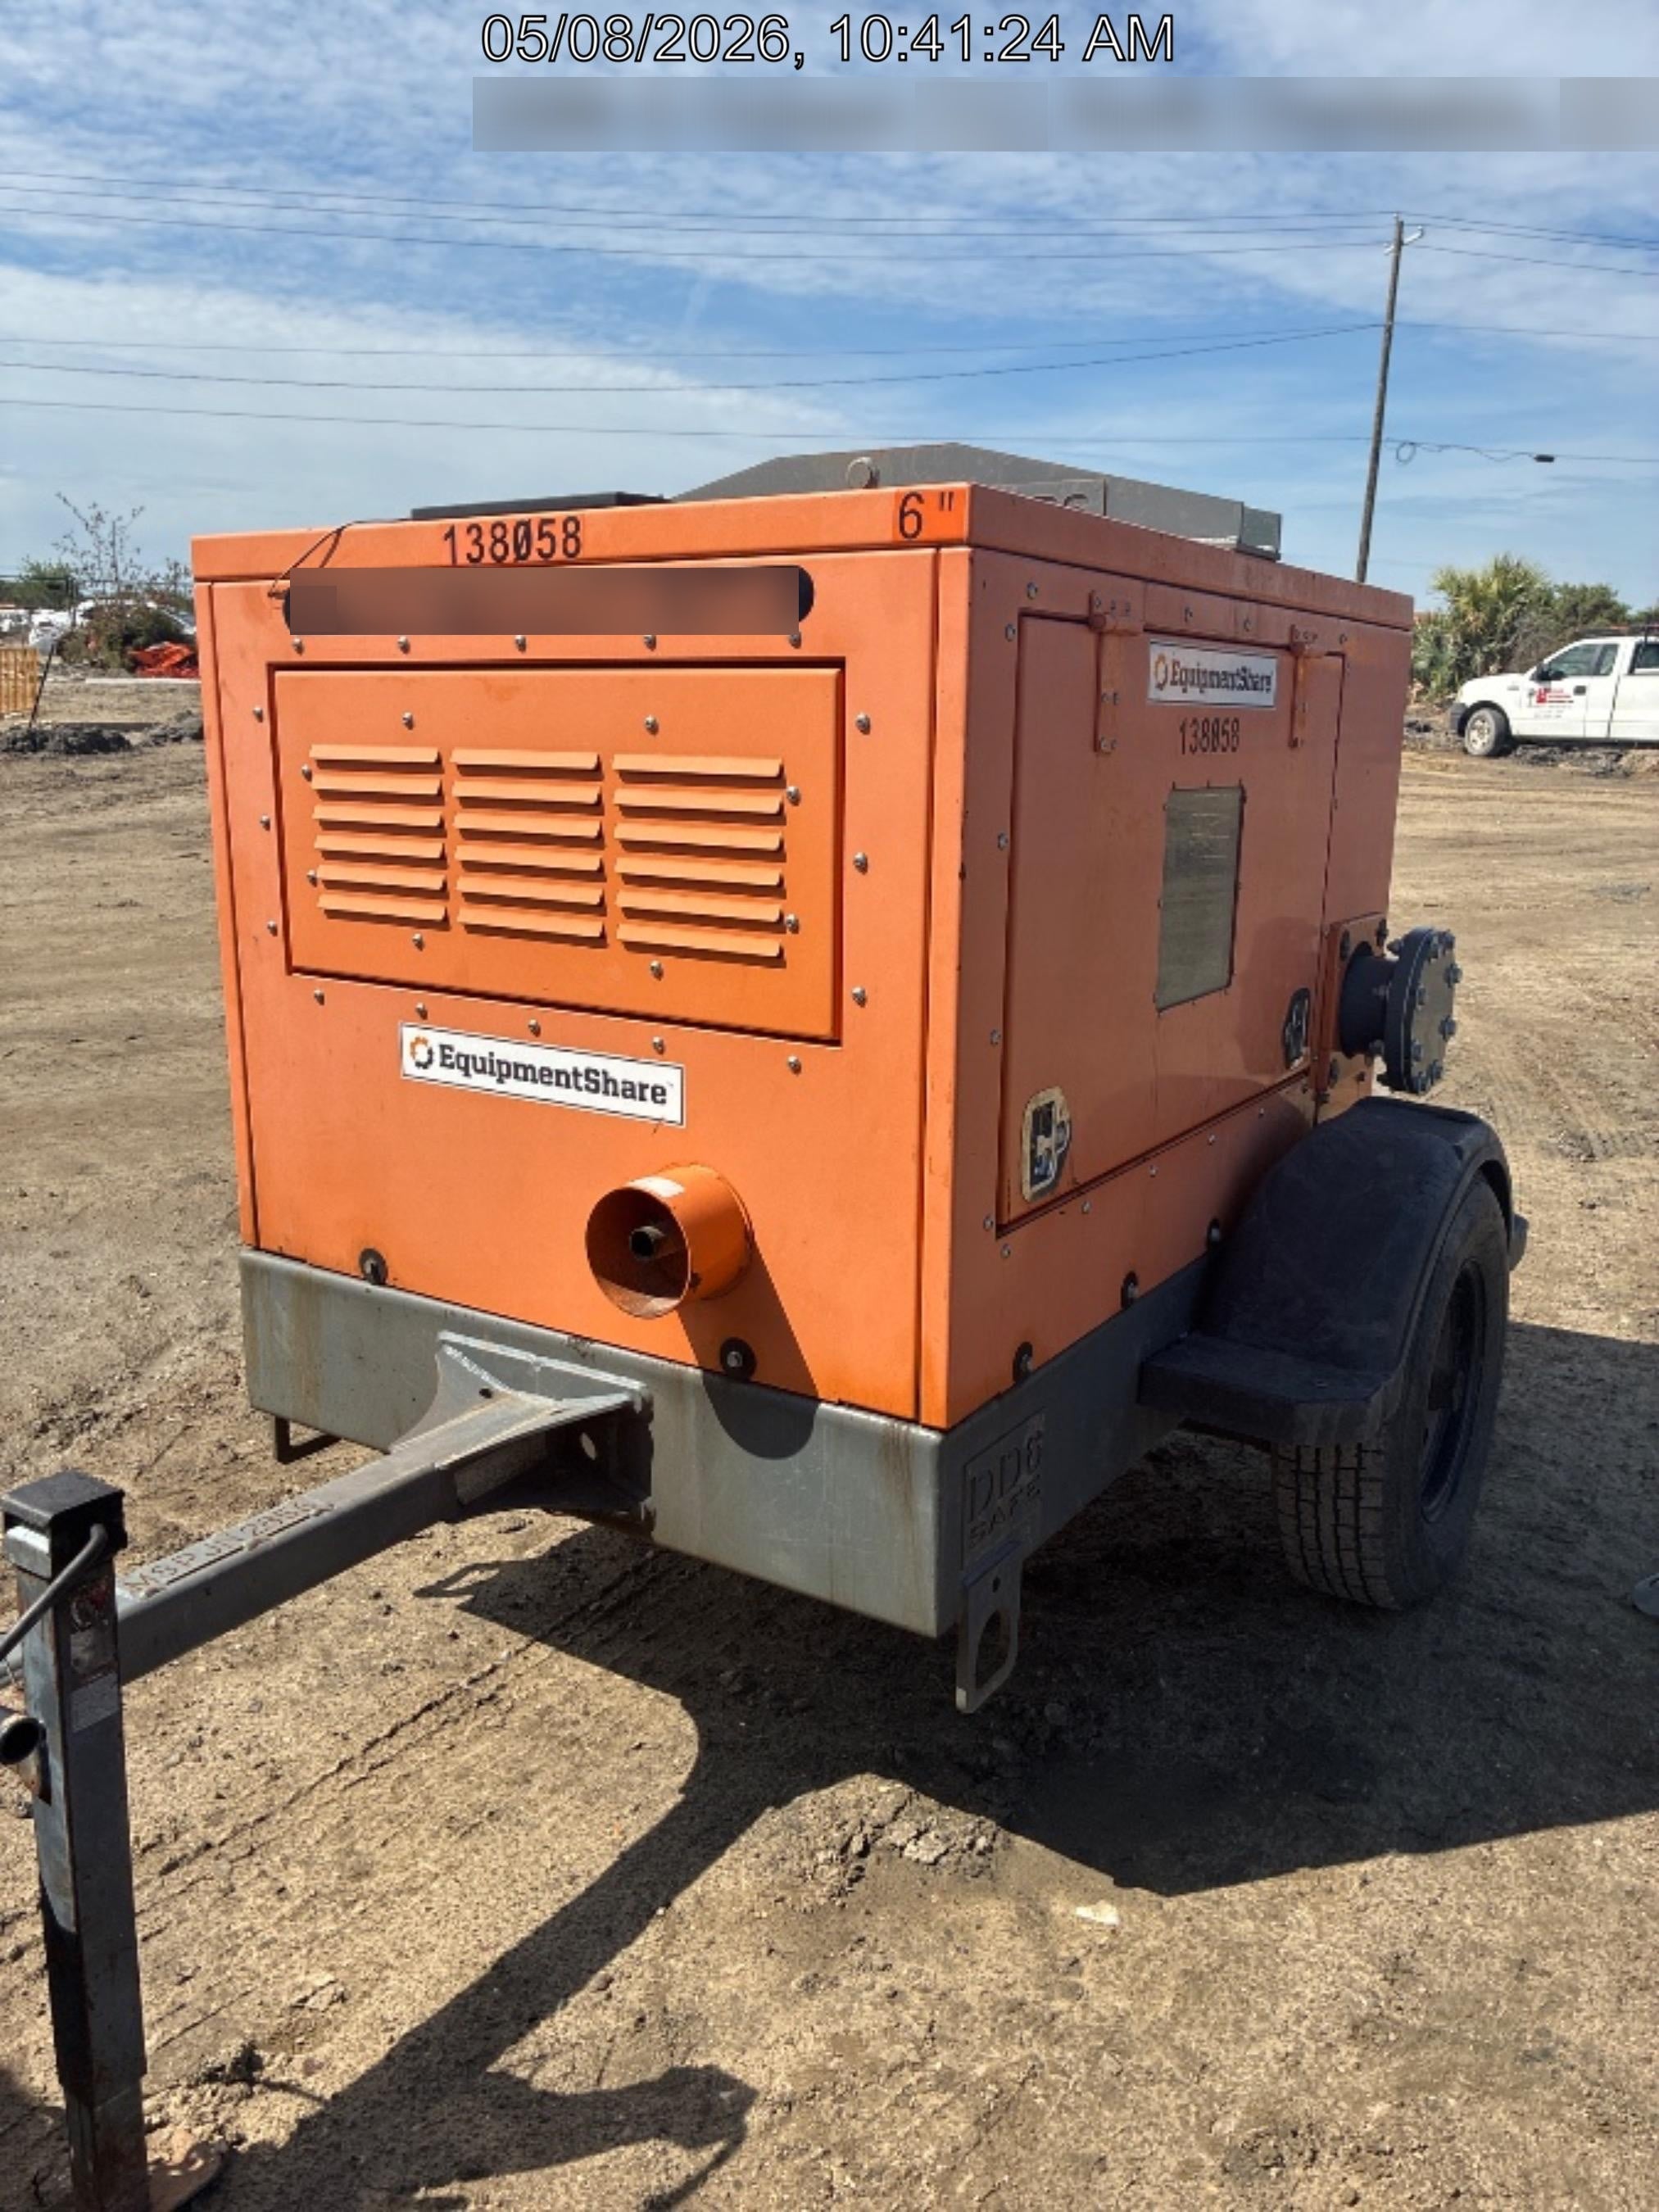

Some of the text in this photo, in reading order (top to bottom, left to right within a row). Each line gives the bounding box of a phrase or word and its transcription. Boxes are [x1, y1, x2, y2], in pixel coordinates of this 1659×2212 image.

[444, 515, 581, 565] 138058
[1169, 659, 1272, 694] EquipmentShare
[1180, 718, 1240, 755] 138058
[438, 1044, 668, 1105] EquipmentShare
